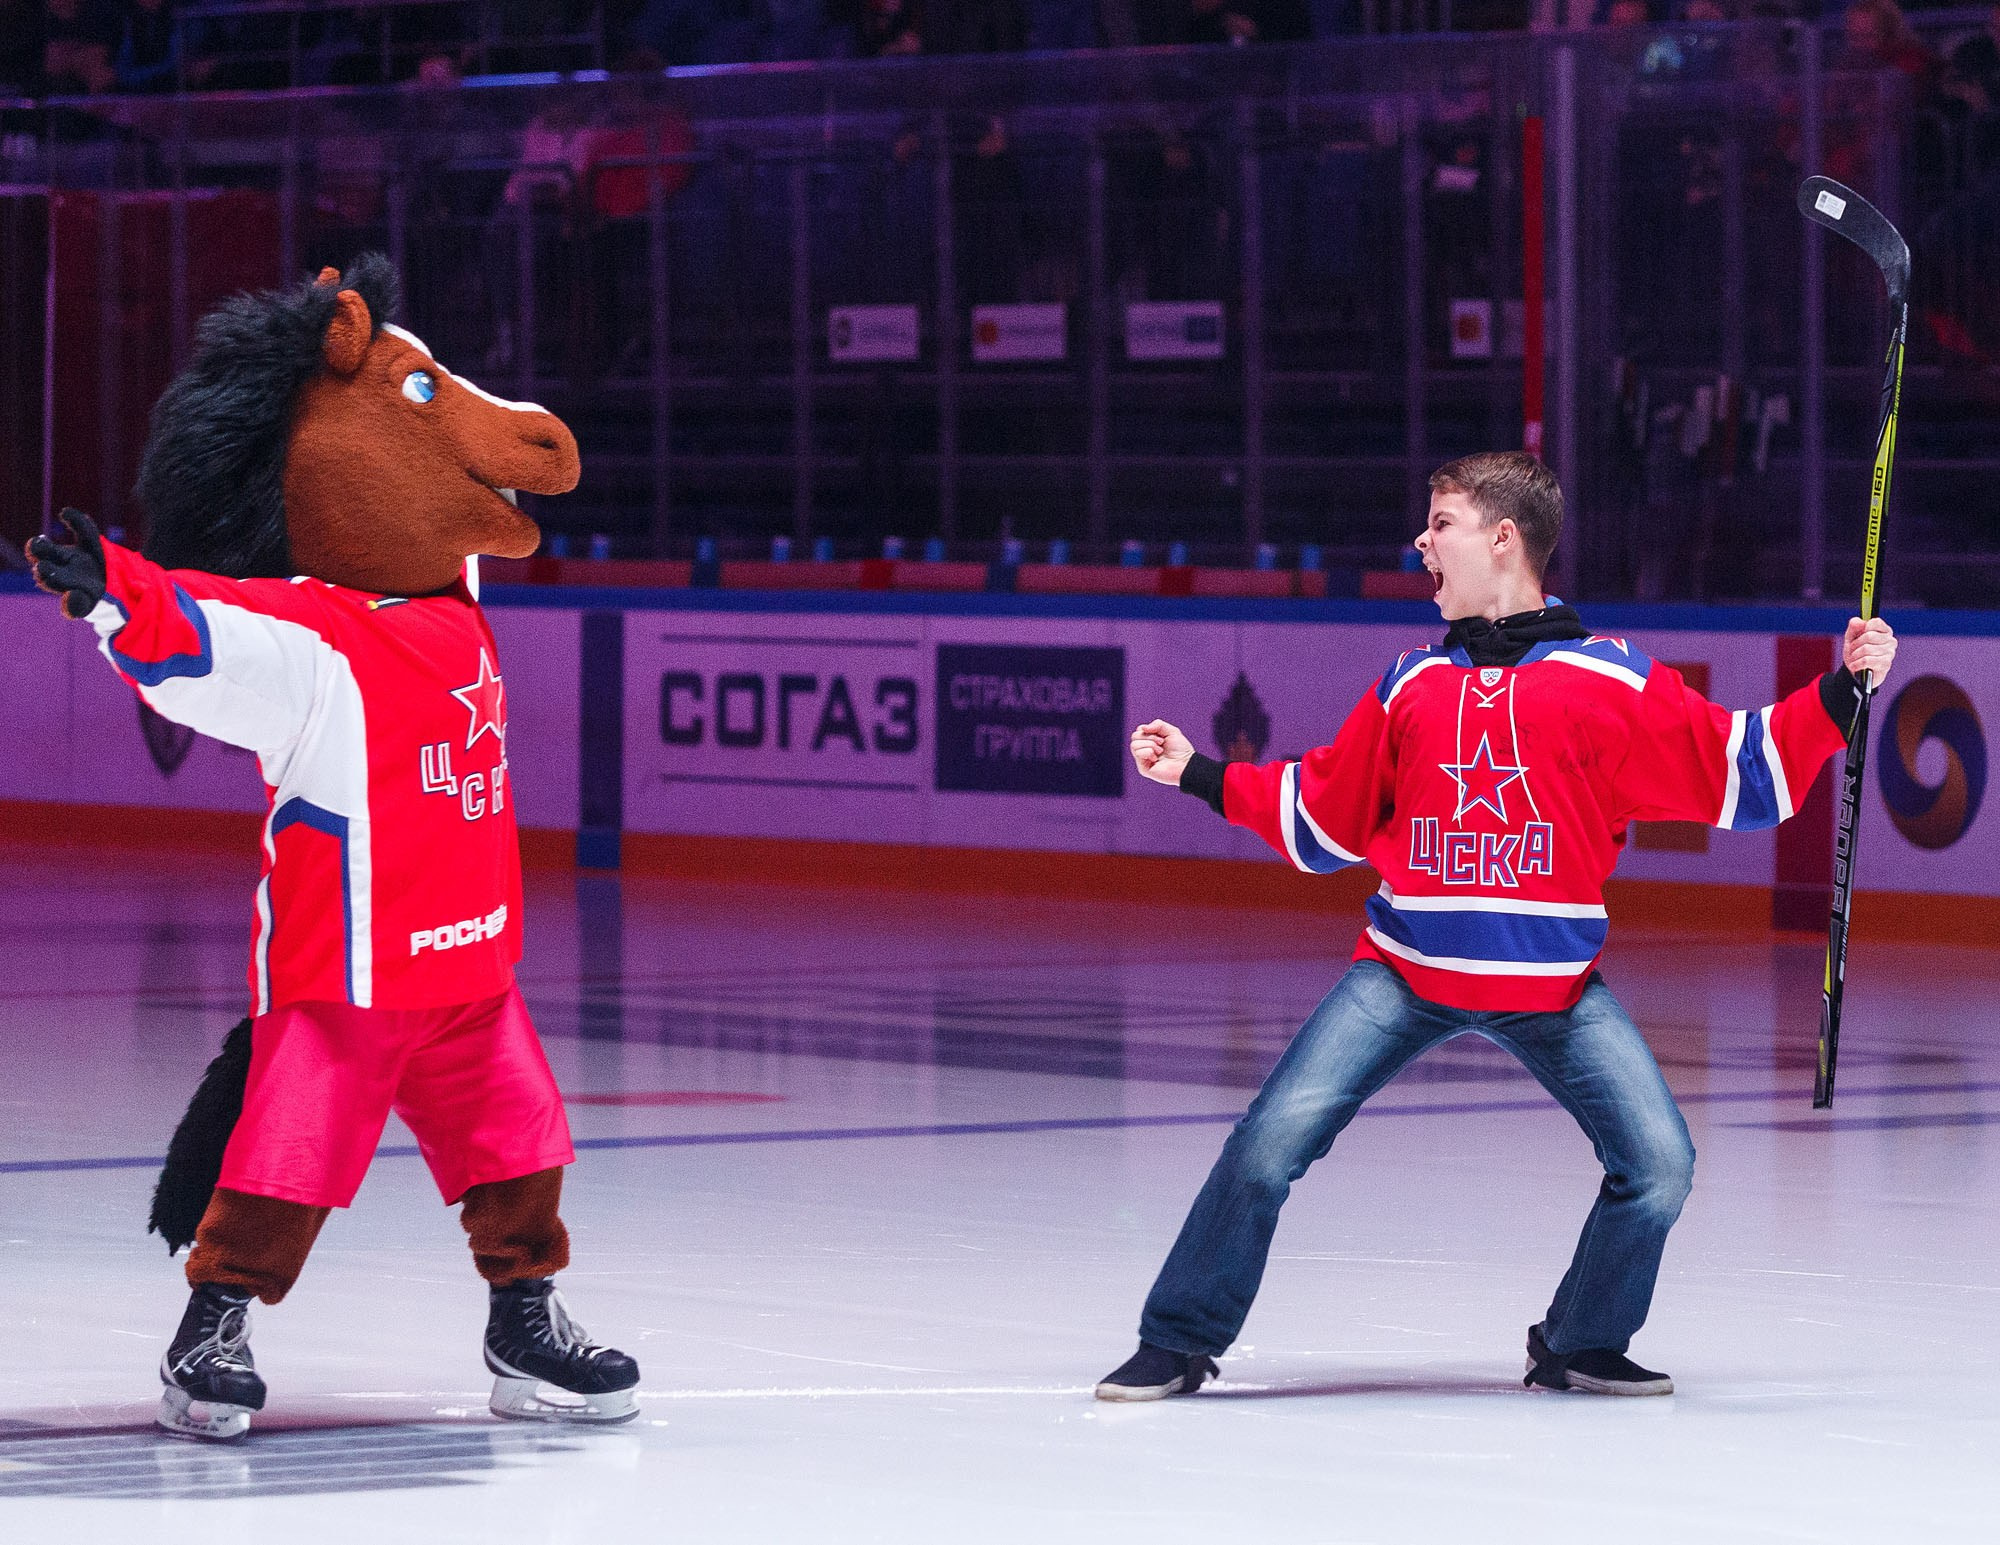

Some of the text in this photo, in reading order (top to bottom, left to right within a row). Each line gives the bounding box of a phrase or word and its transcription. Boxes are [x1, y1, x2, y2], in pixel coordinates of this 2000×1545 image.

[660, 671, 918, 754] СОГАЗ
[950, 674, 1114, 712] СТРАХОВАЯ
[975, 723, 1083, 761] ГРУППА
[1408, 816, 1554, 888] ЦСКА
